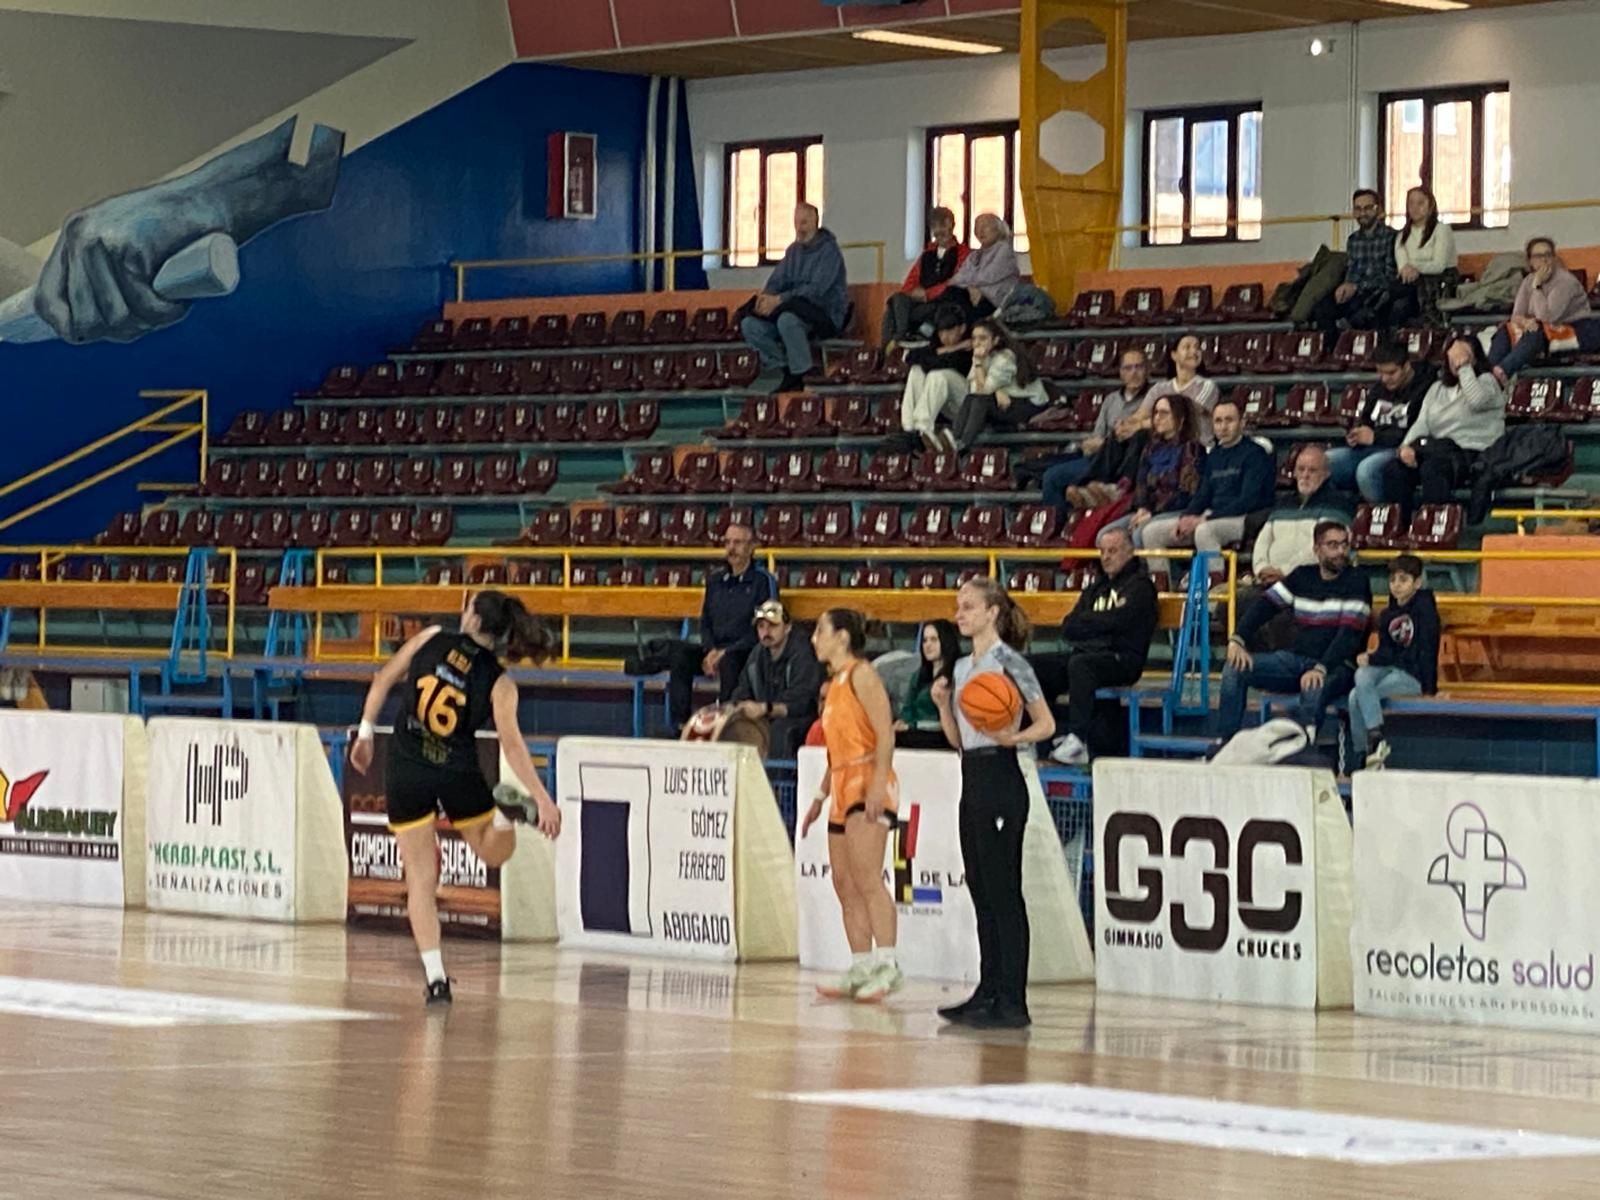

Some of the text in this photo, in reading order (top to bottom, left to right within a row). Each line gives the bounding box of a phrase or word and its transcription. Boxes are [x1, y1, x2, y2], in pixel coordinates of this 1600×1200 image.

[416, 675, 466, 738] 16
[663, 766, 728, 797] LUIS FELIPE
[691, 805, 728, 839] GÓMEZ
[82, 843, 117, 858] ZAMORA
[678, 850, 726, 882] FERRERO
[801, 862, 818, 878] LA
[920, 870, 941, 886] DE
[1104, 811, 1303, 952] G3C
[662, 910, 731, 946] ABOGADO
[1104, 928, 1302, 961] GIMNASIO CRUCES
[1366, 941, 1594, 992] recoletas salud
